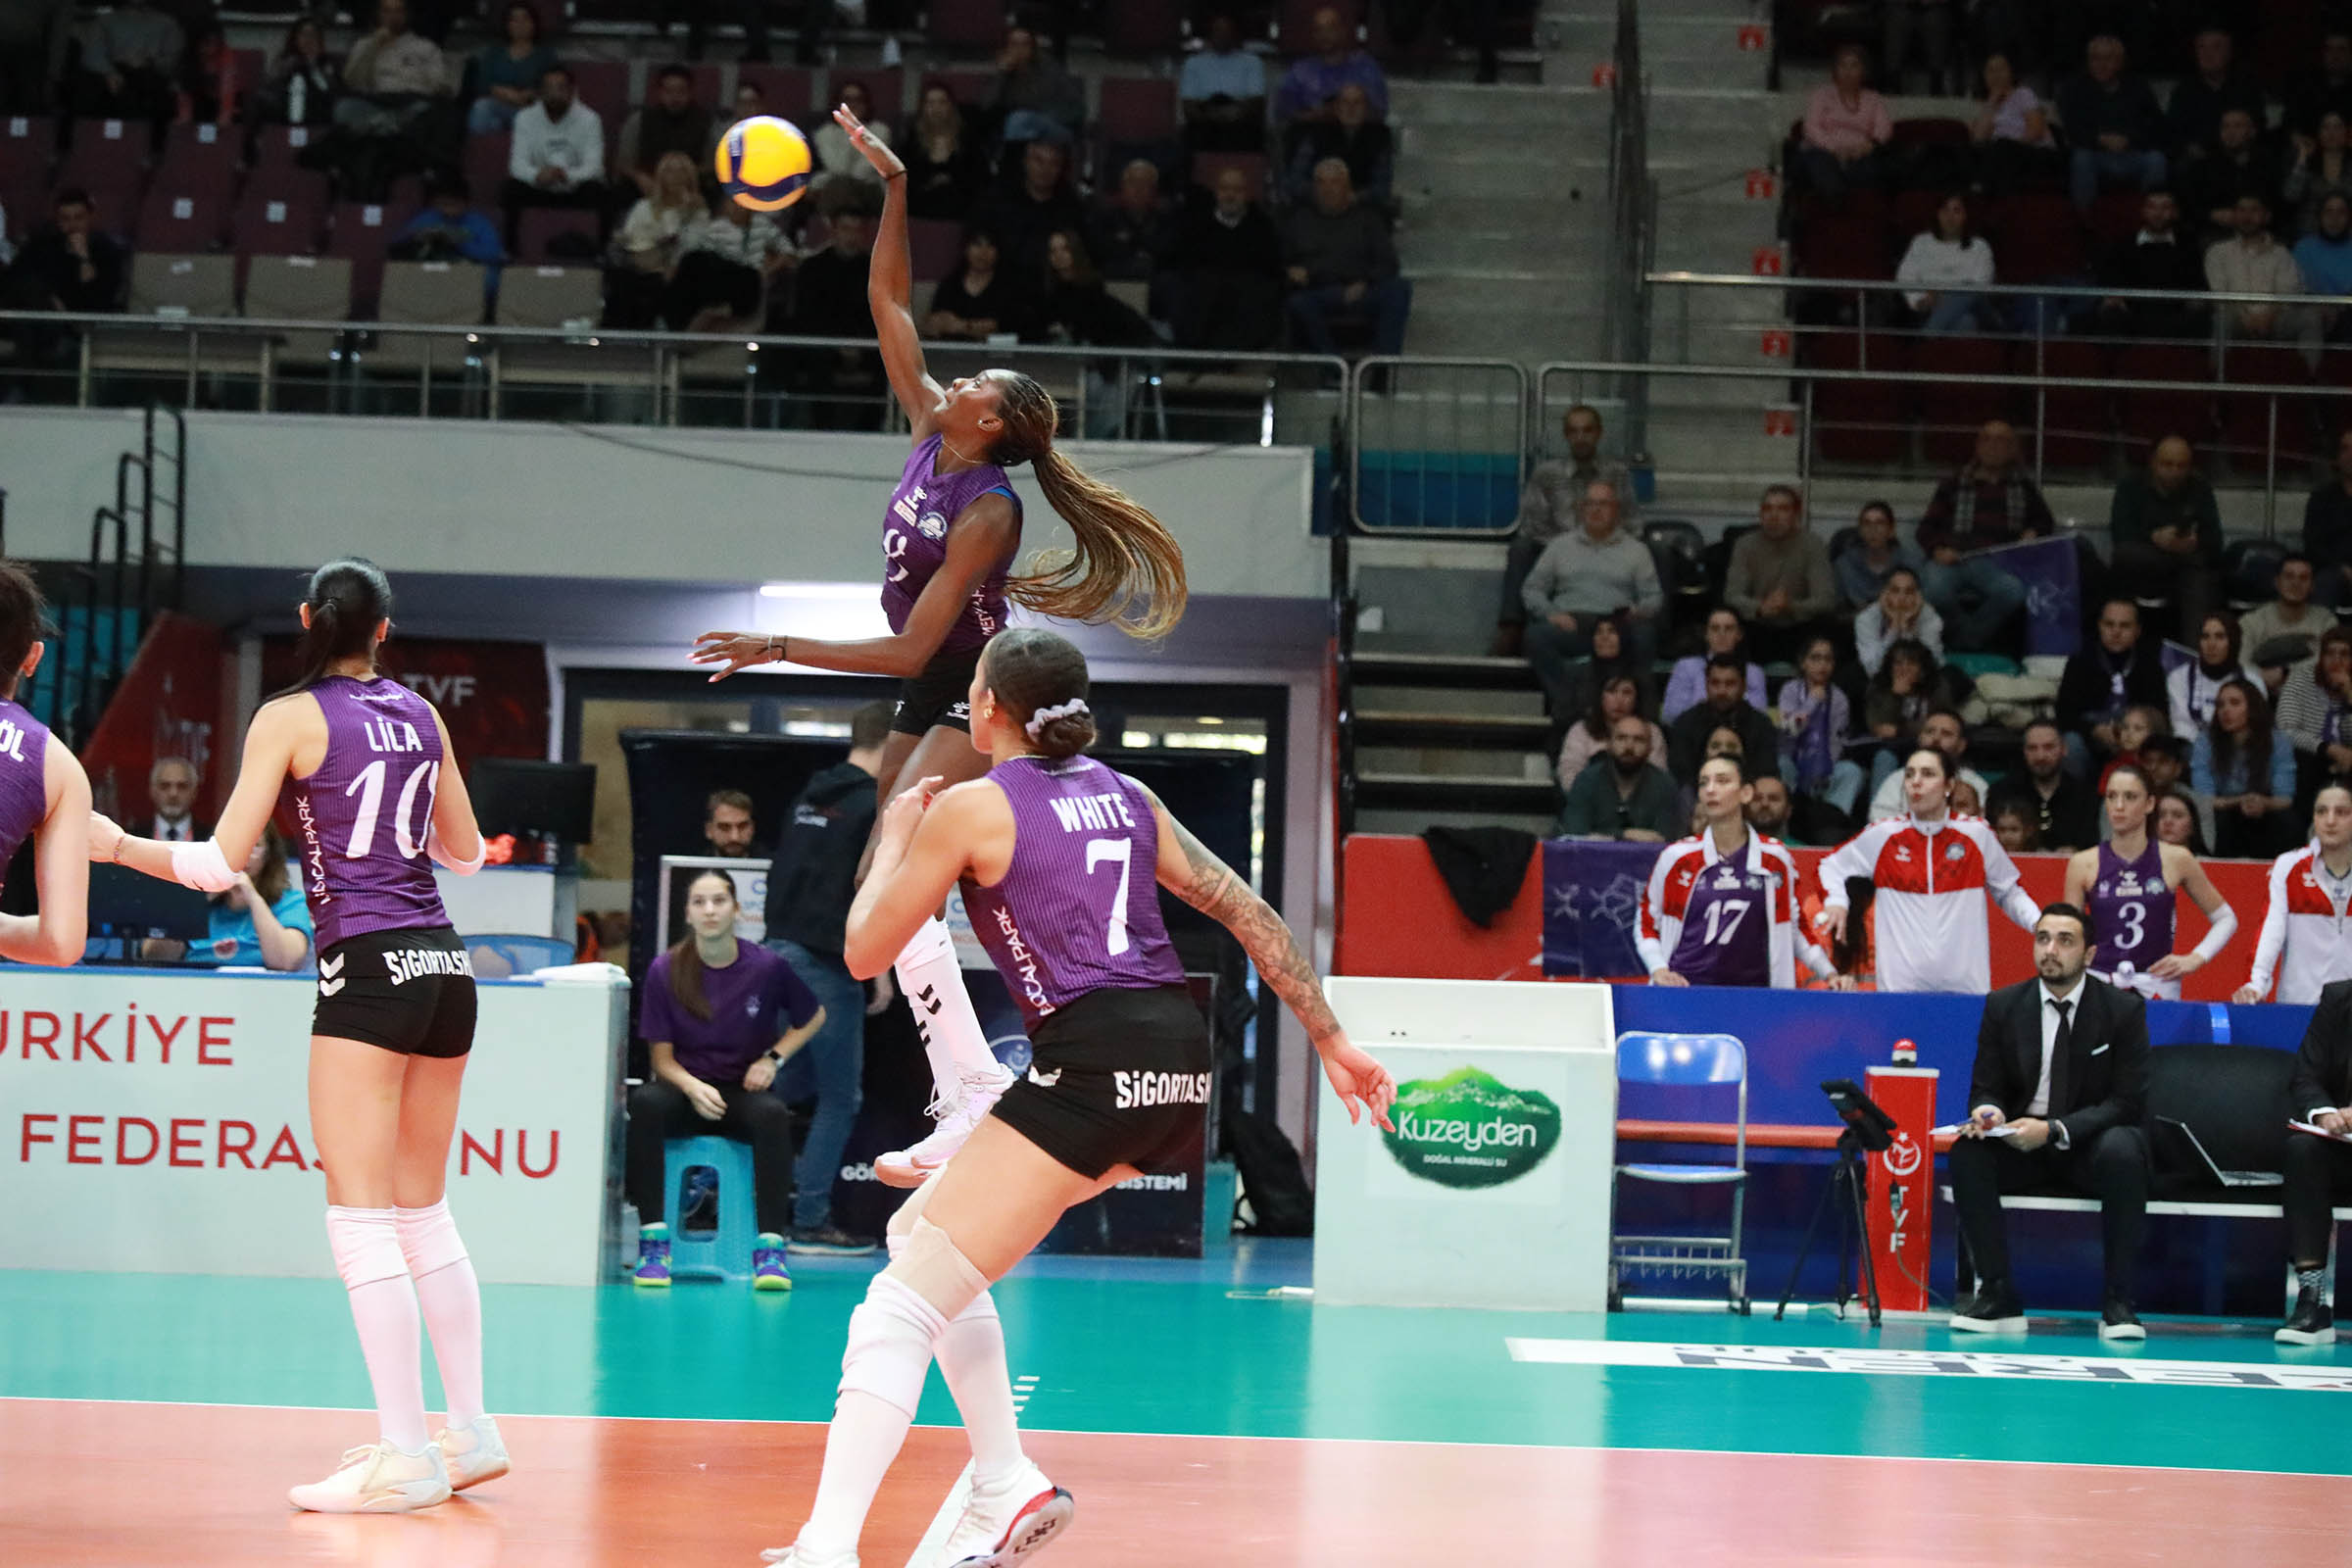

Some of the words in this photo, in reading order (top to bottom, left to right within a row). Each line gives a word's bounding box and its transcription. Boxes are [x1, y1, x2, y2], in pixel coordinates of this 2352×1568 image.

[403, 673, 476, 707] TVF
[364, 716, 423, 752] LİLA
[345, 760, 439, 858] 10
[1049, 792, 1137, 833] WHITE
[1087, 837, 1132, 956] 7
[1703, 899, 1752, 946] 17
[2114, 902, 2146, 950] 3
[20, 1113, 561, 1179] FEDERANU
[1398, 1110, 1538, 1152] Kuzeyden
[1889, 1186, 1910, 1253] TVF
